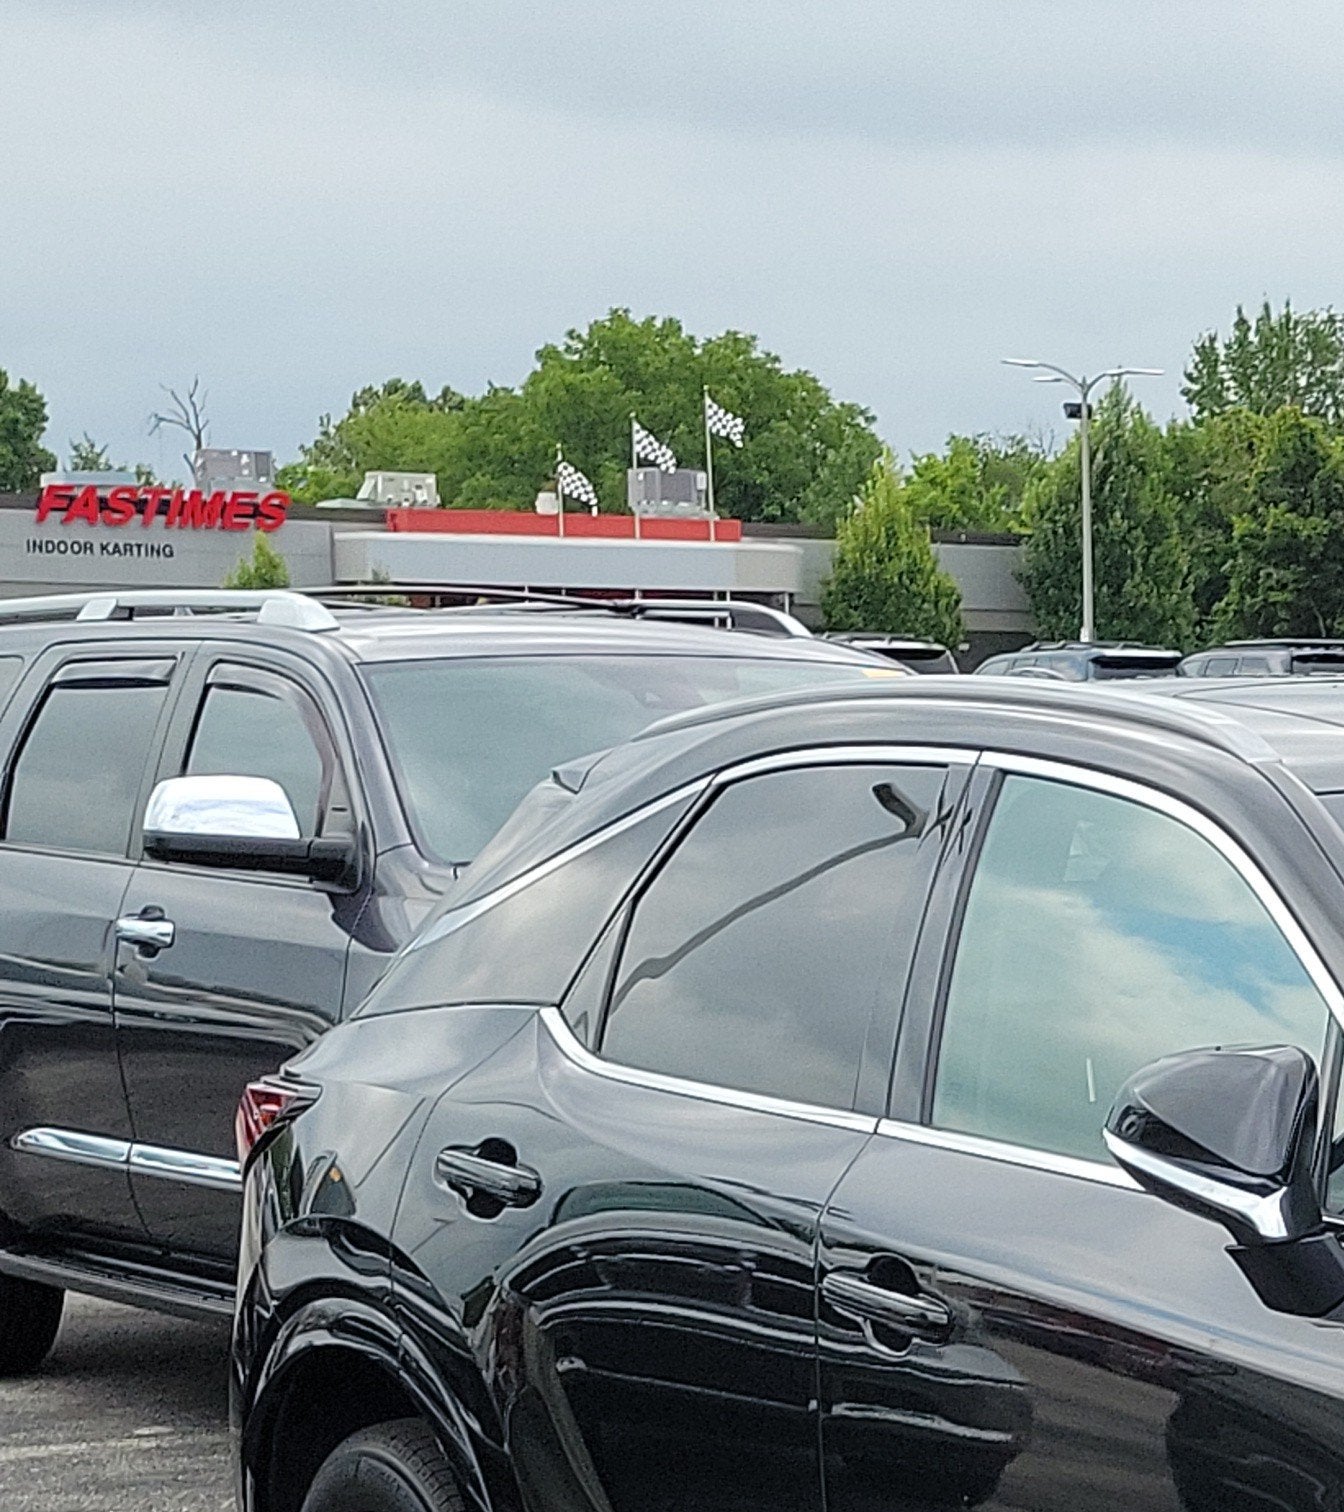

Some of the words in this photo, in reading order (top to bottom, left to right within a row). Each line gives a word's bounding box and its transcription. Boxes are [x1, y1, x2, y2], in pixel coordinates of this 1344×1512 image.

[36, 484, 292, 532] FASTIMES
[26, 539, 94, 555] INDOOR
[99, 541, 174, 558] KARTING
